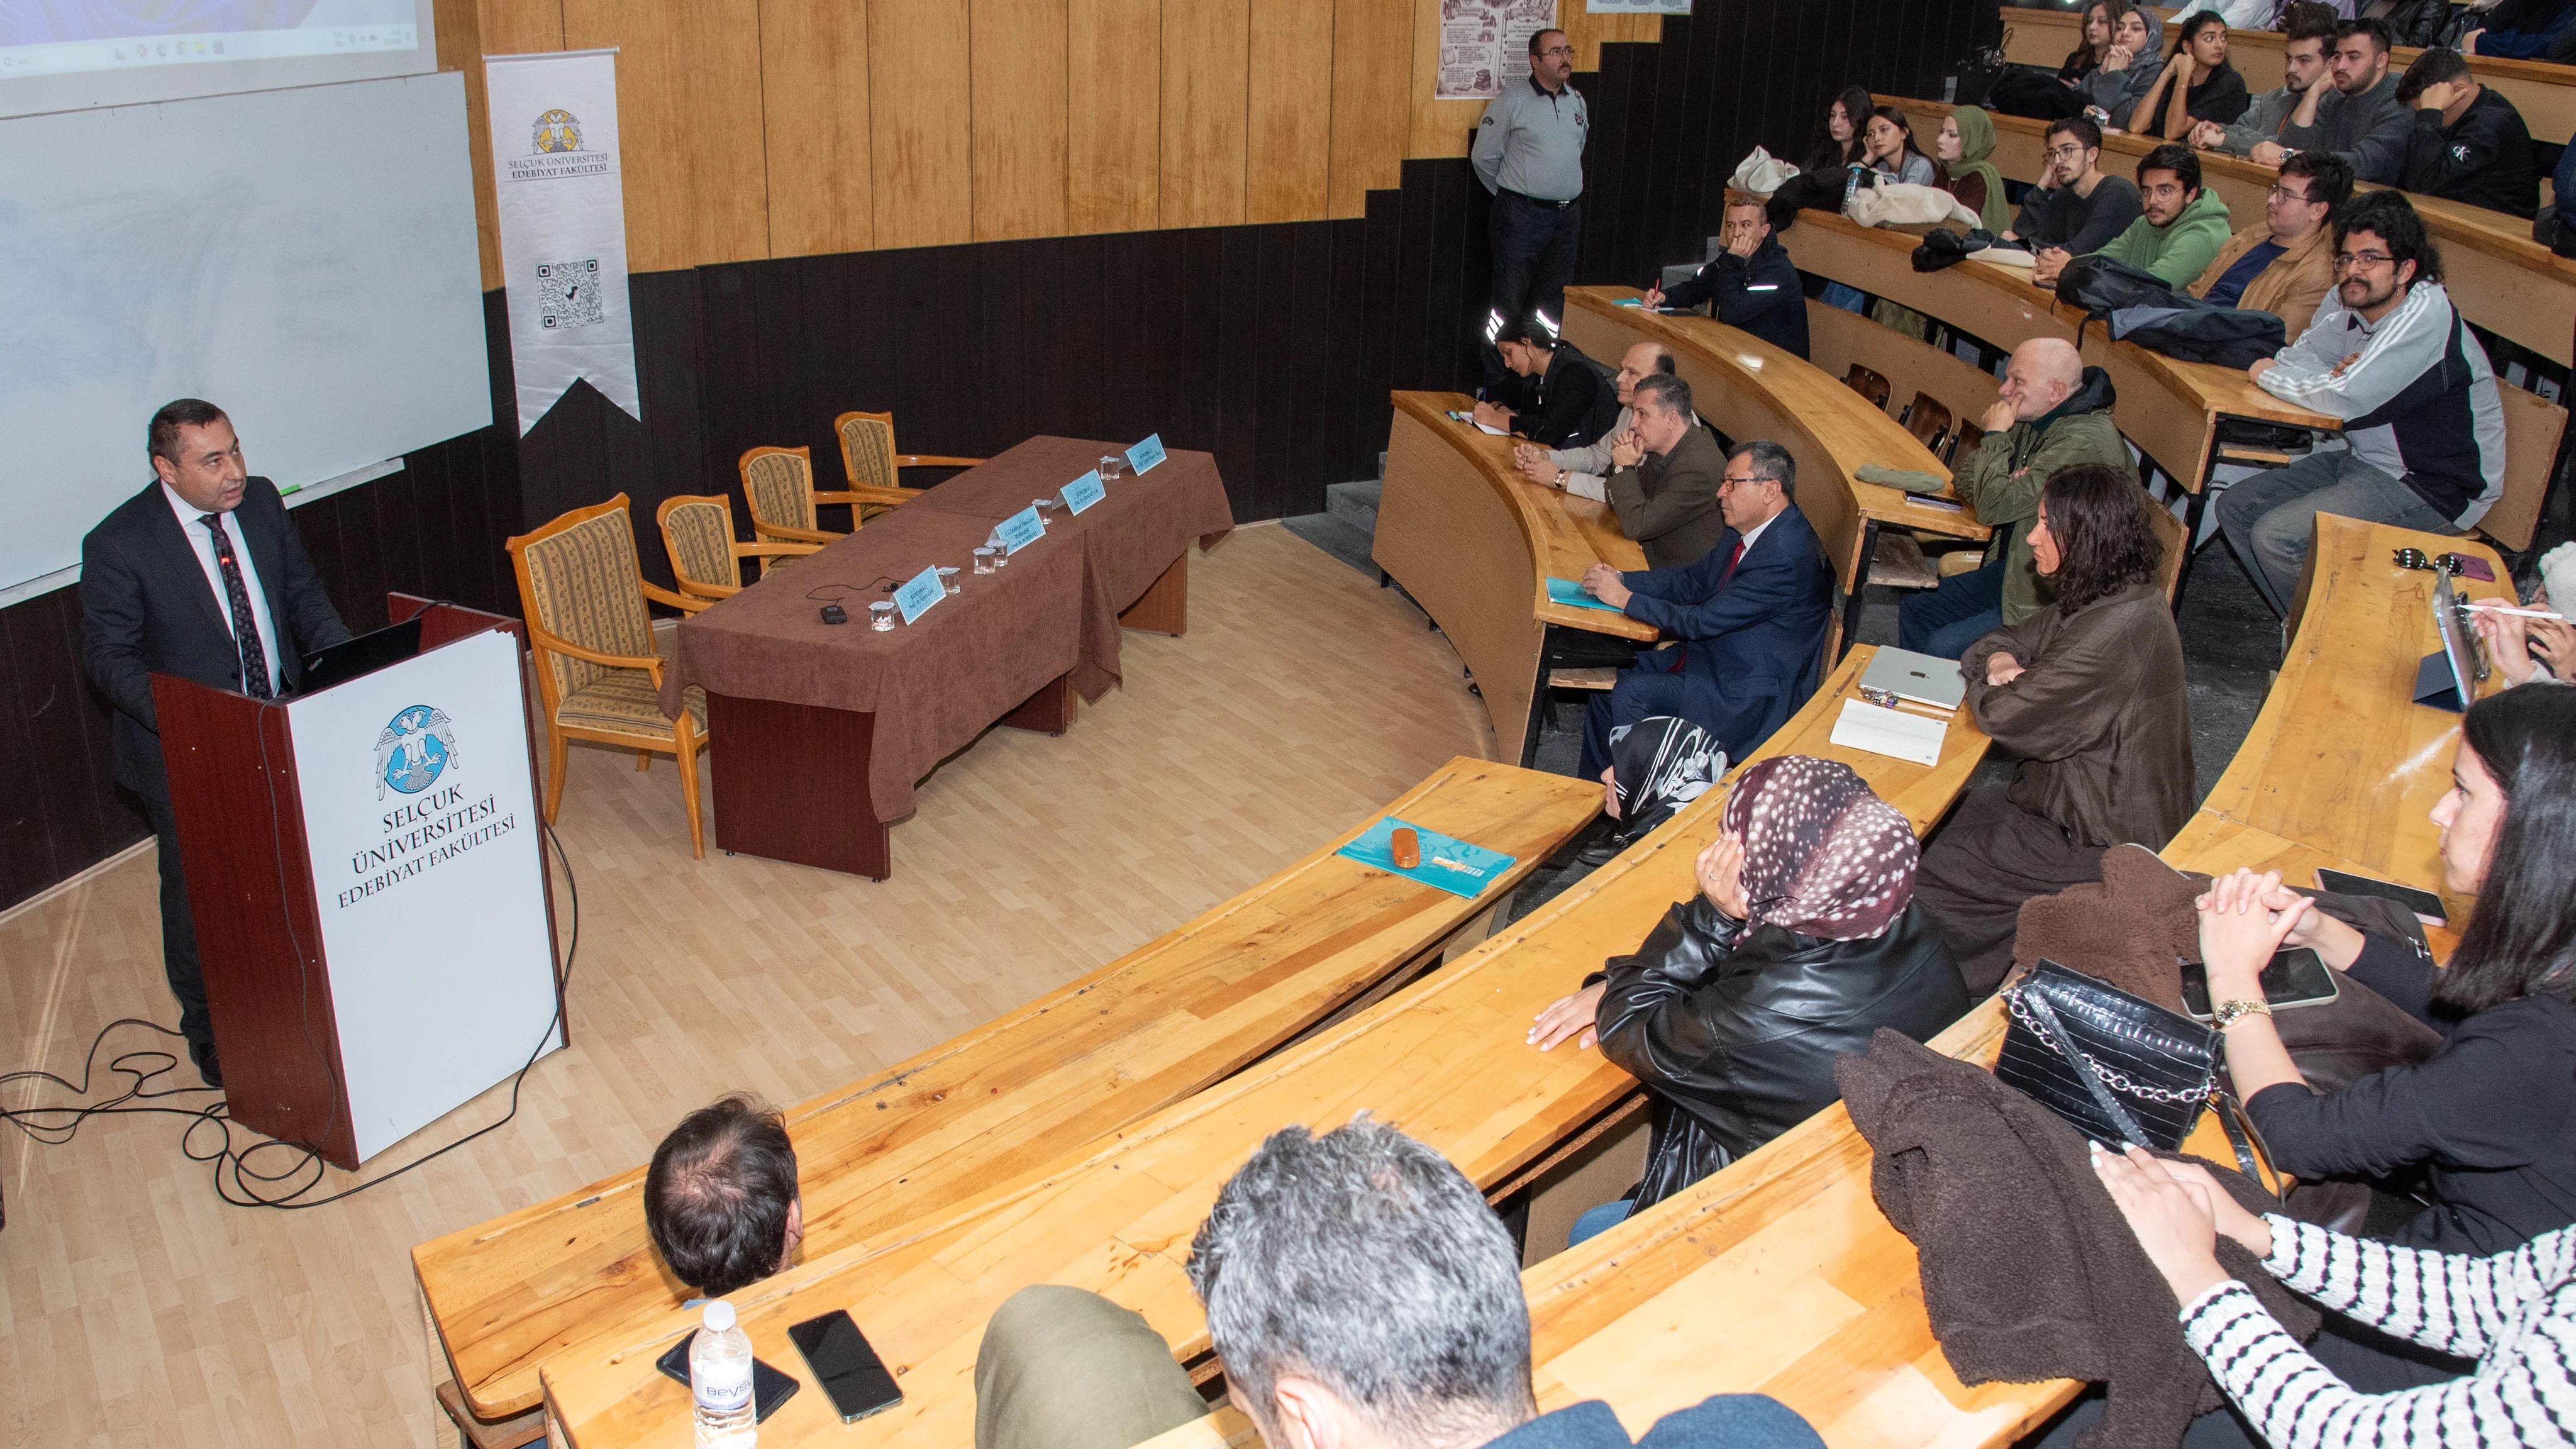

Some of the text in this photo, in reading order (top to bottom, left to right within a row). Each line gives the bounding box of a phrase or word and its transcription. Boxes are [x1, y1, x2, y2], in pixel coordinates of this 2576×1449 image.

[508, 153, 608, 169] SELÇUK ÜNİVERSİTESİ
[512, 163, 607, 179] EDEBİYAT FAKÜLTESİ
[352, 793, 498, 874] ÜNİVERSİTESİ
[383, 783, 464, 835] SELÇUK
[338, 813, 516, 909] EDEBİYAT FAKÜLTESİ
